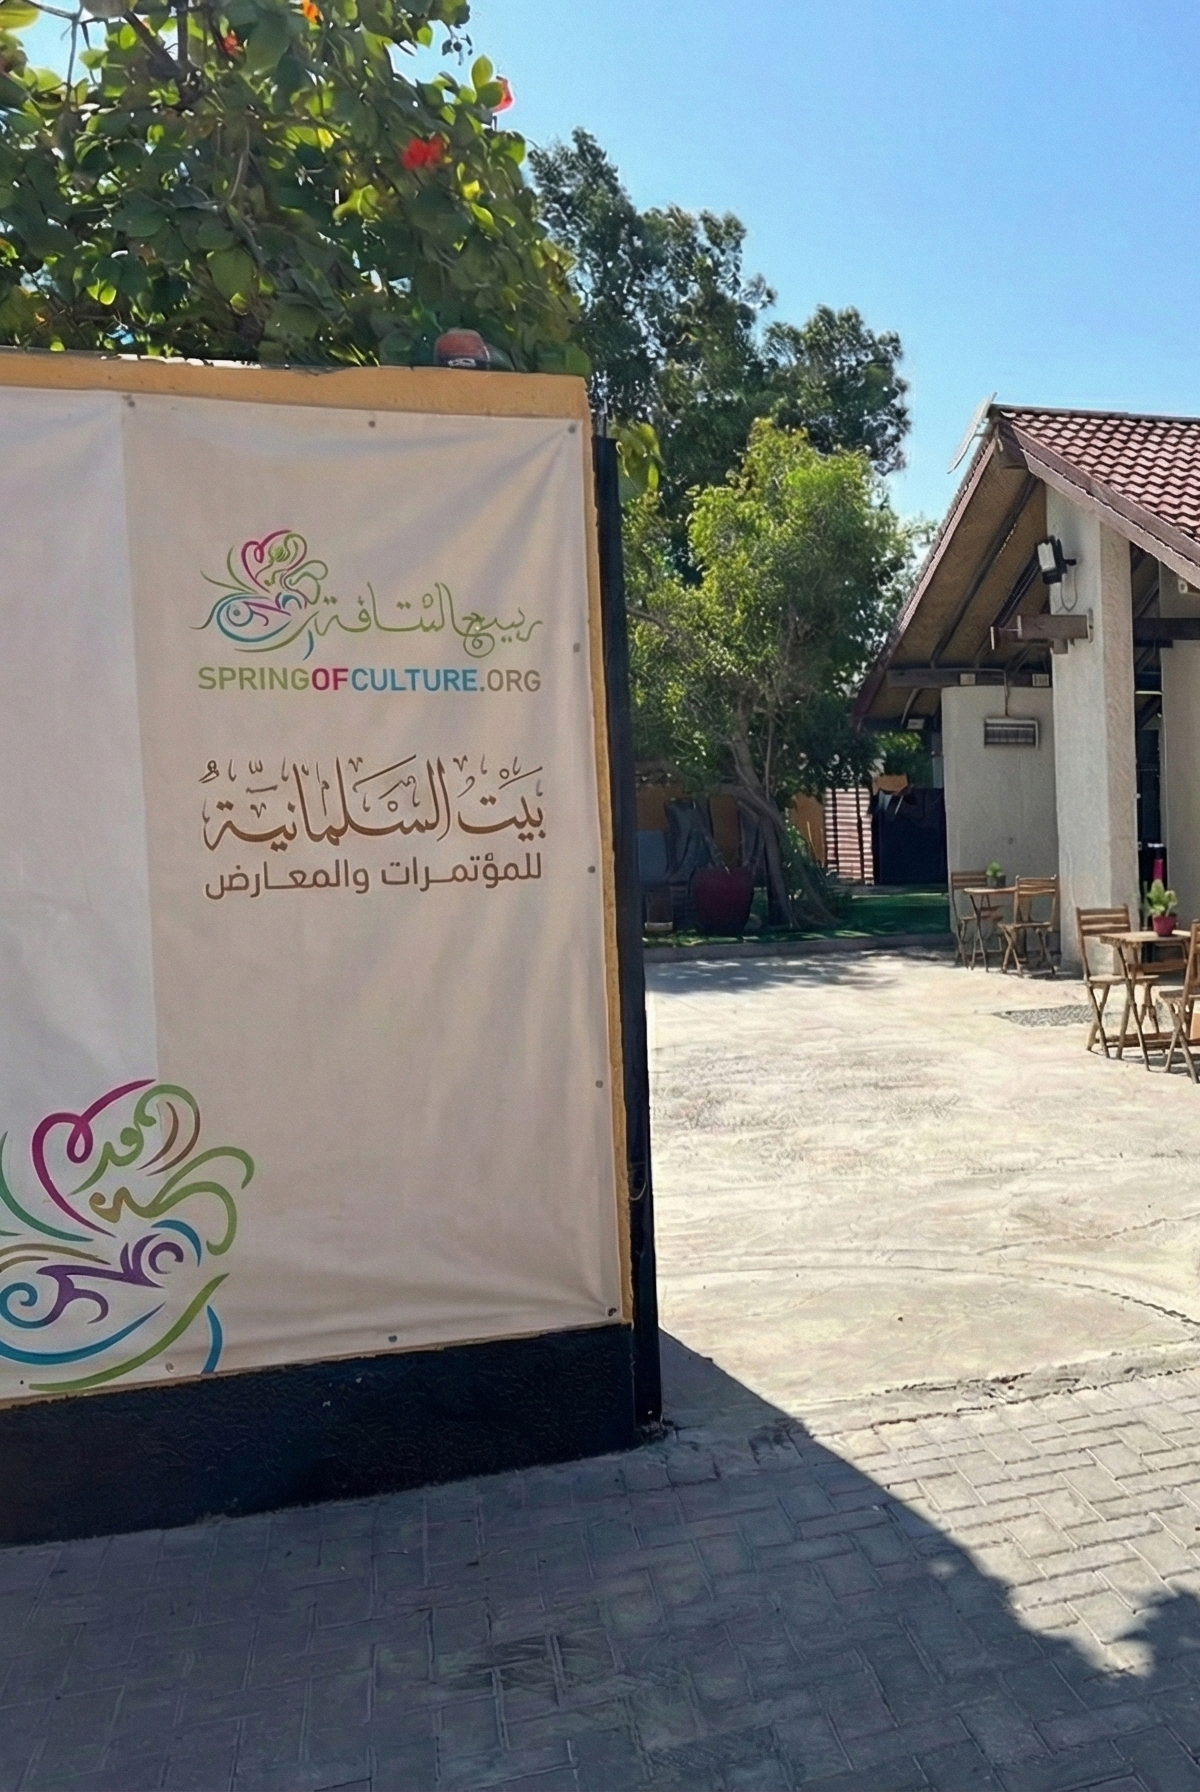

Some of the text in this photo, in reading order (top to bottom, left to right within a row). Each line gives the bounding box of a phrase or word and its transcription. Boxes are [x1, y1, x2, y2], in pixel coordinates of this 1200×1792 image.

[197, 665, 542, 693] SPRINGOFCULTURE.ORG
[204, 851, 543, 901] للمؤتمرات والمعارض
